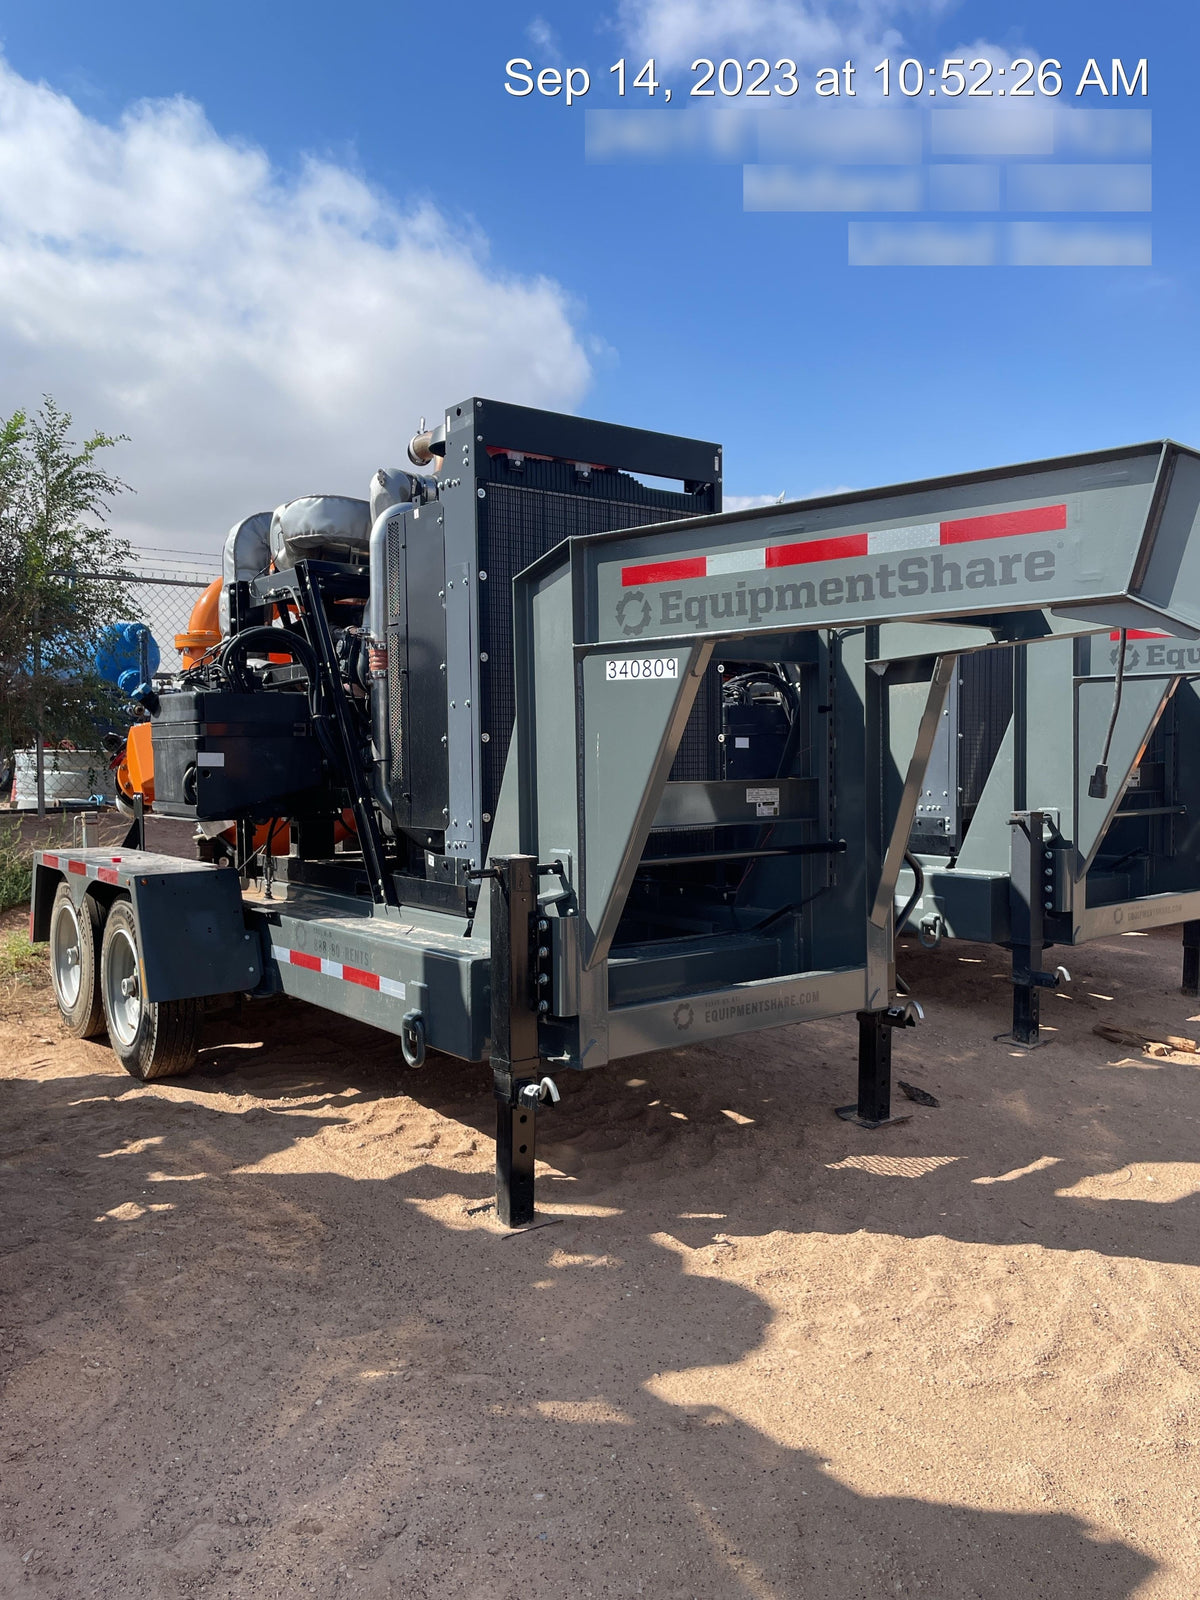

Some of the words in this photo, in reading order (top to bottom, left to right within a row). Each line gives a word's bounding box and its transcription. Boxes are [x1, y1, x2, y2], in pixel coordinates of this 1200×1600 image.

[659, 549, 1056, 628] EquipmentShare
[608, 658, 676, 679] 340809
[704, 990, 820, 1024] EQUIPMENTSHARE.COM
